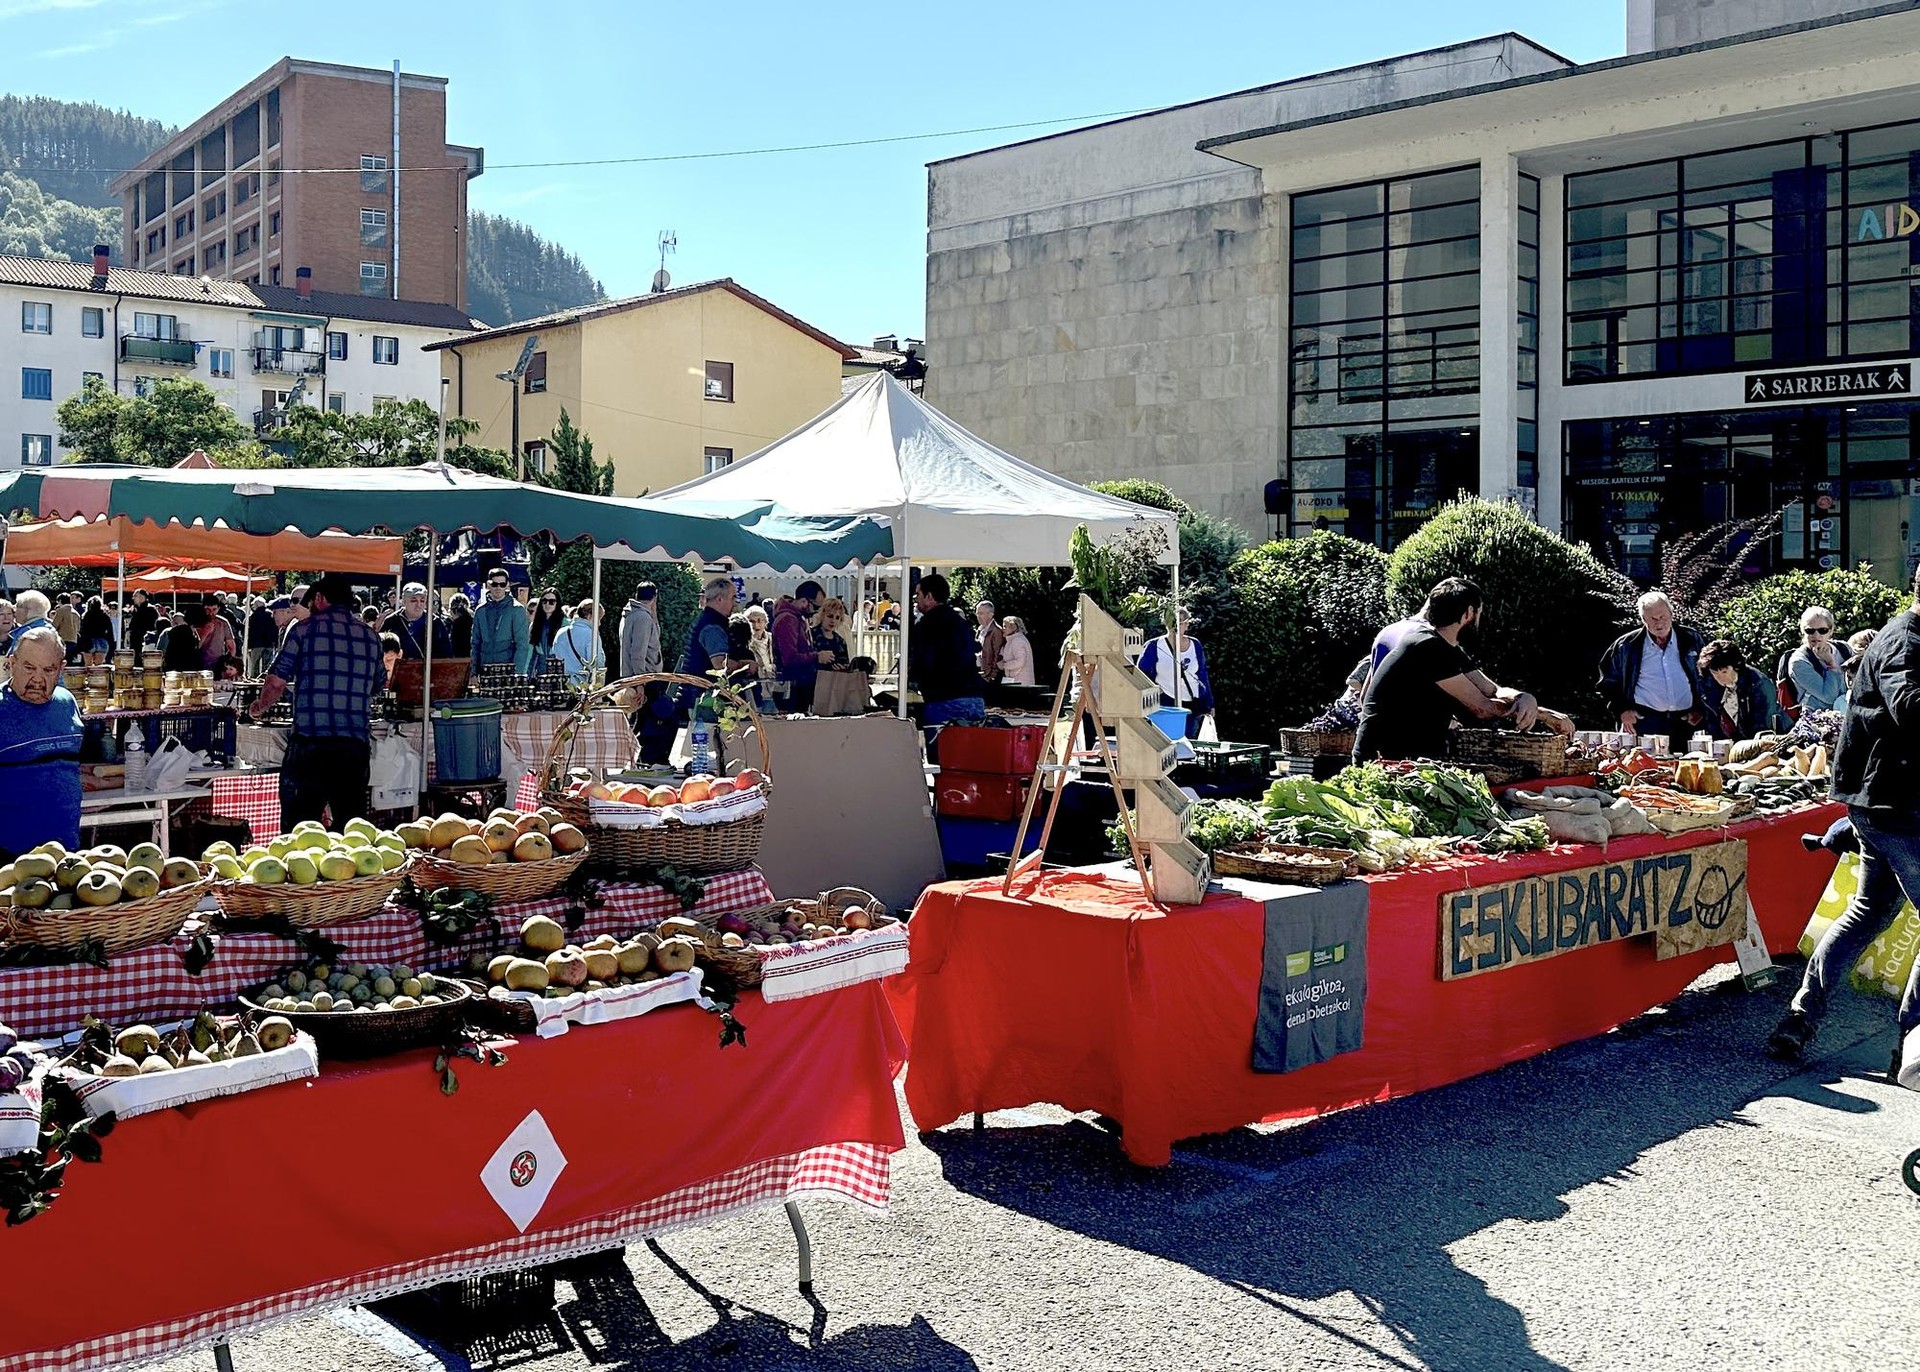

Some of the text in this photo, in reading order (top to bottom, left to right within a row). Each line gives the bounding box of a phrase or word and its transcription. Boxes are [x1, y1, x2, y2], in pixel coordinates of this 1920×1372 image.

[1772, 372, 1881, 395] SARRERAK
[1642, 475, 1650, 483] EZ
[1451, 853, 1693, 975] ESKUBARATZ
[1285, 979, 1345, 1006] ekologikoa,
[1286, 1013, 1306, 1028] dena
